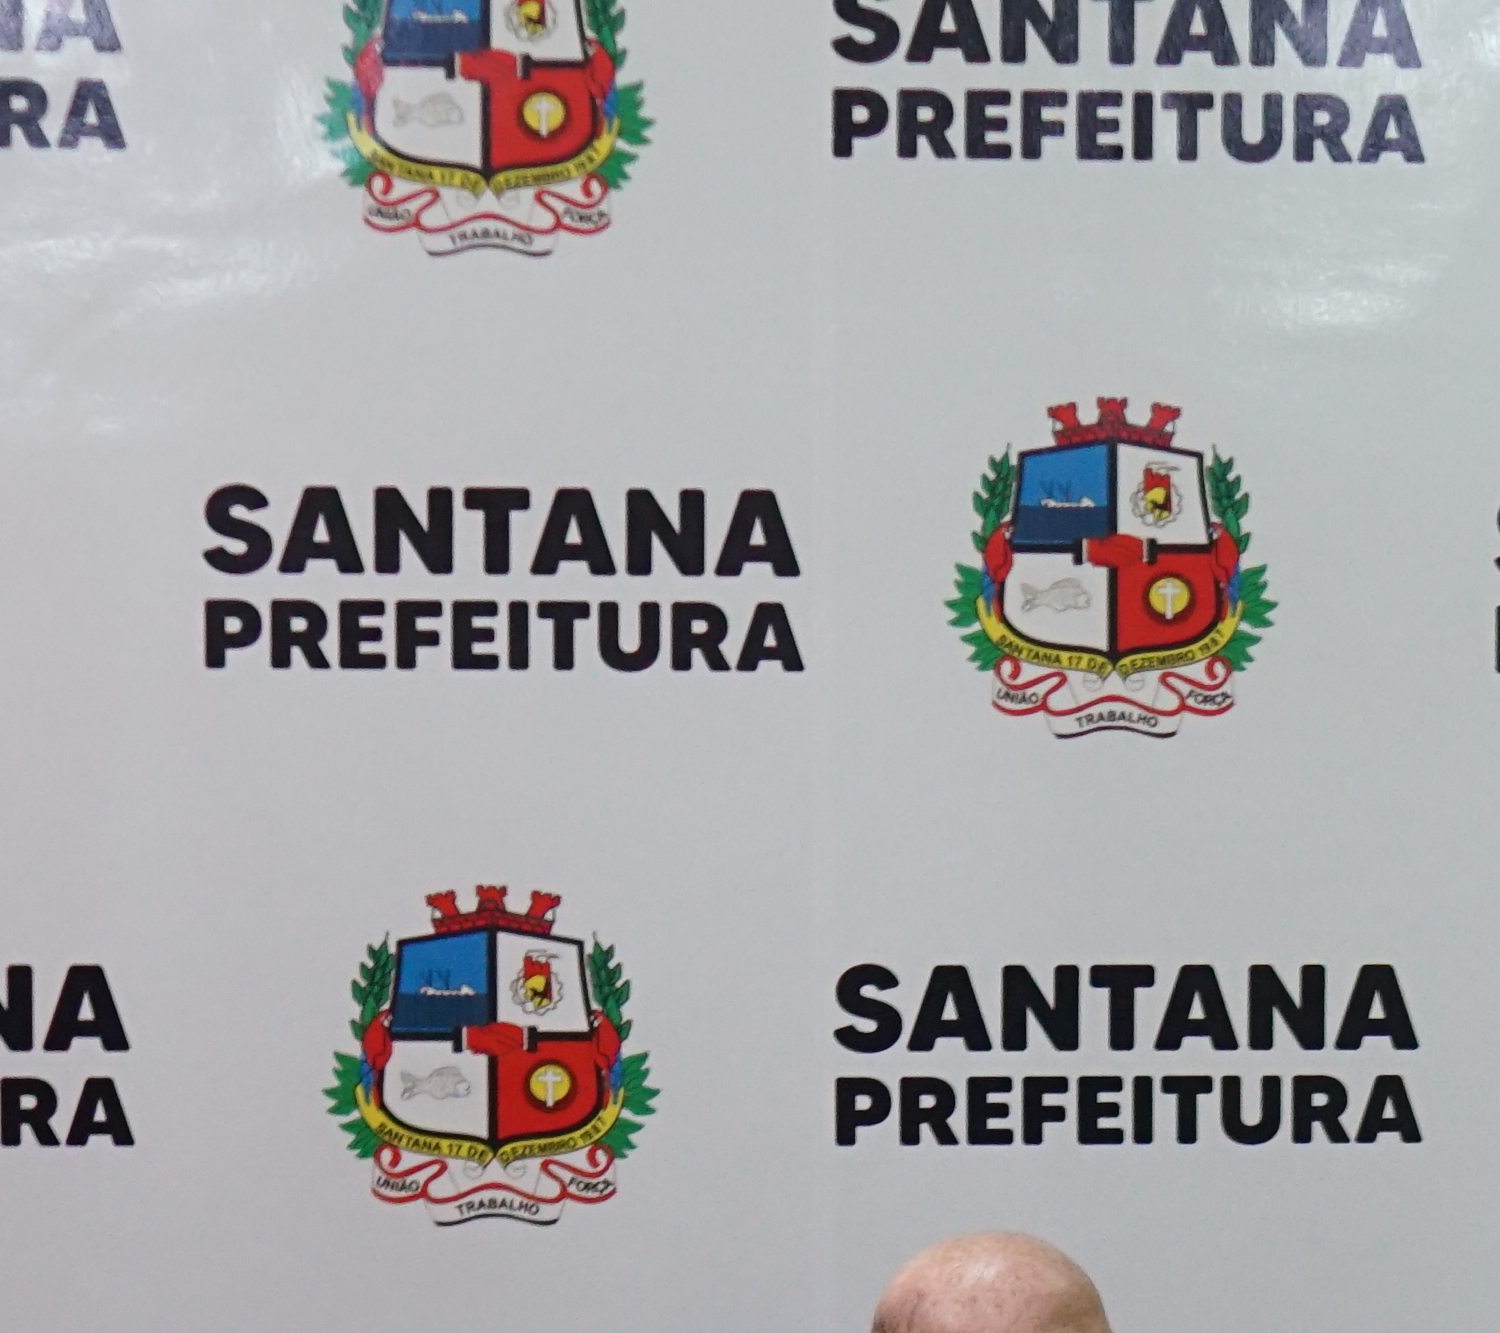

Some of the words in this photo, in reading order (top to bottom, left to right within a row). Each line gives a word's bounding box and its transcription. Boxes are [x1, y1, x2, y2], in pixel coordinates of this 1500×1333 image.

[832, 0, 1422, 67] SANTANA
[832, 88, 1425, 164] PREFEITURA
[202, 484, 801, 578] SANTANA
[204, 599, 805, 673] PREFEITURA
[1075, 709, 1159, 729] TRABALHO
[833, 963, 1420, 1054] SANTANA
[835, 1074, 1423, 1147] PREFEITURA
[455, 1197, 540, 1217] TRABALHO
